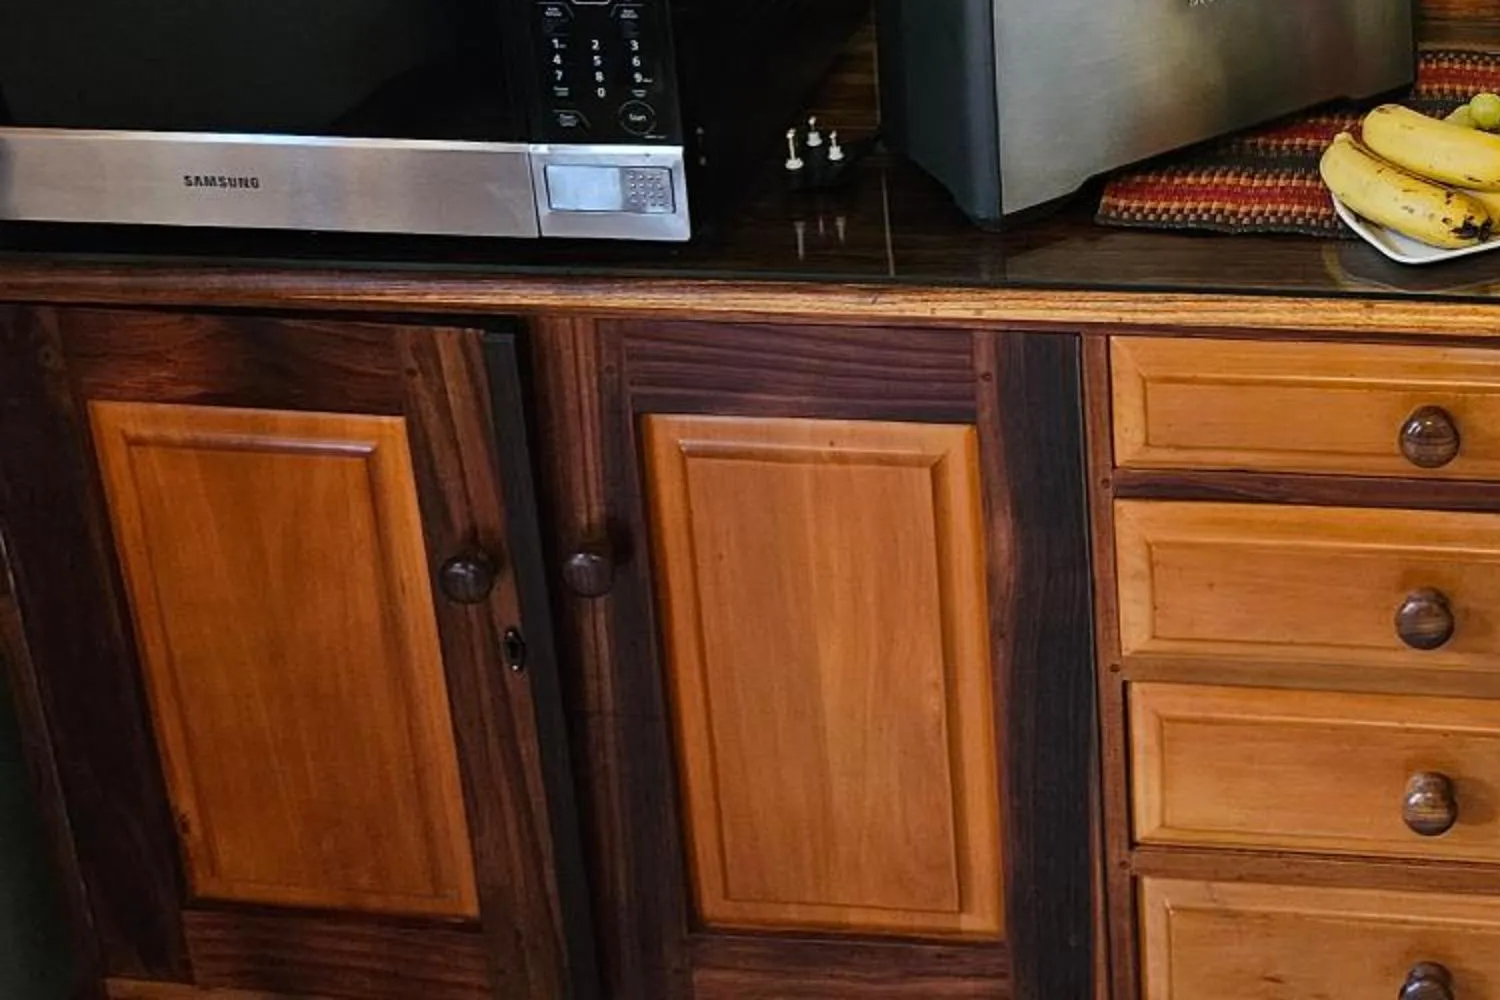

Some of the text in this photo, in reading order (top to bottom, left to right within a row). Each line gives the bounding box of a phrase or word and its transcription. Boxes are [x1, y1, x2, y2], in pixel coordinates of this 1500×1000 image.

[552, 38, 559, 49] 1
[591, 39, 600, 50] 2
[629, 39, 639, 51] 3
[552, 53, 562, 65] 4
[631, 55, 641, 67] 6
[555, 69, 563, 81] 7
[633, 71, 643, 83] 9
[597, 86, 606, 98] 0
[183, 175, 260, 189] SAMSUNG
